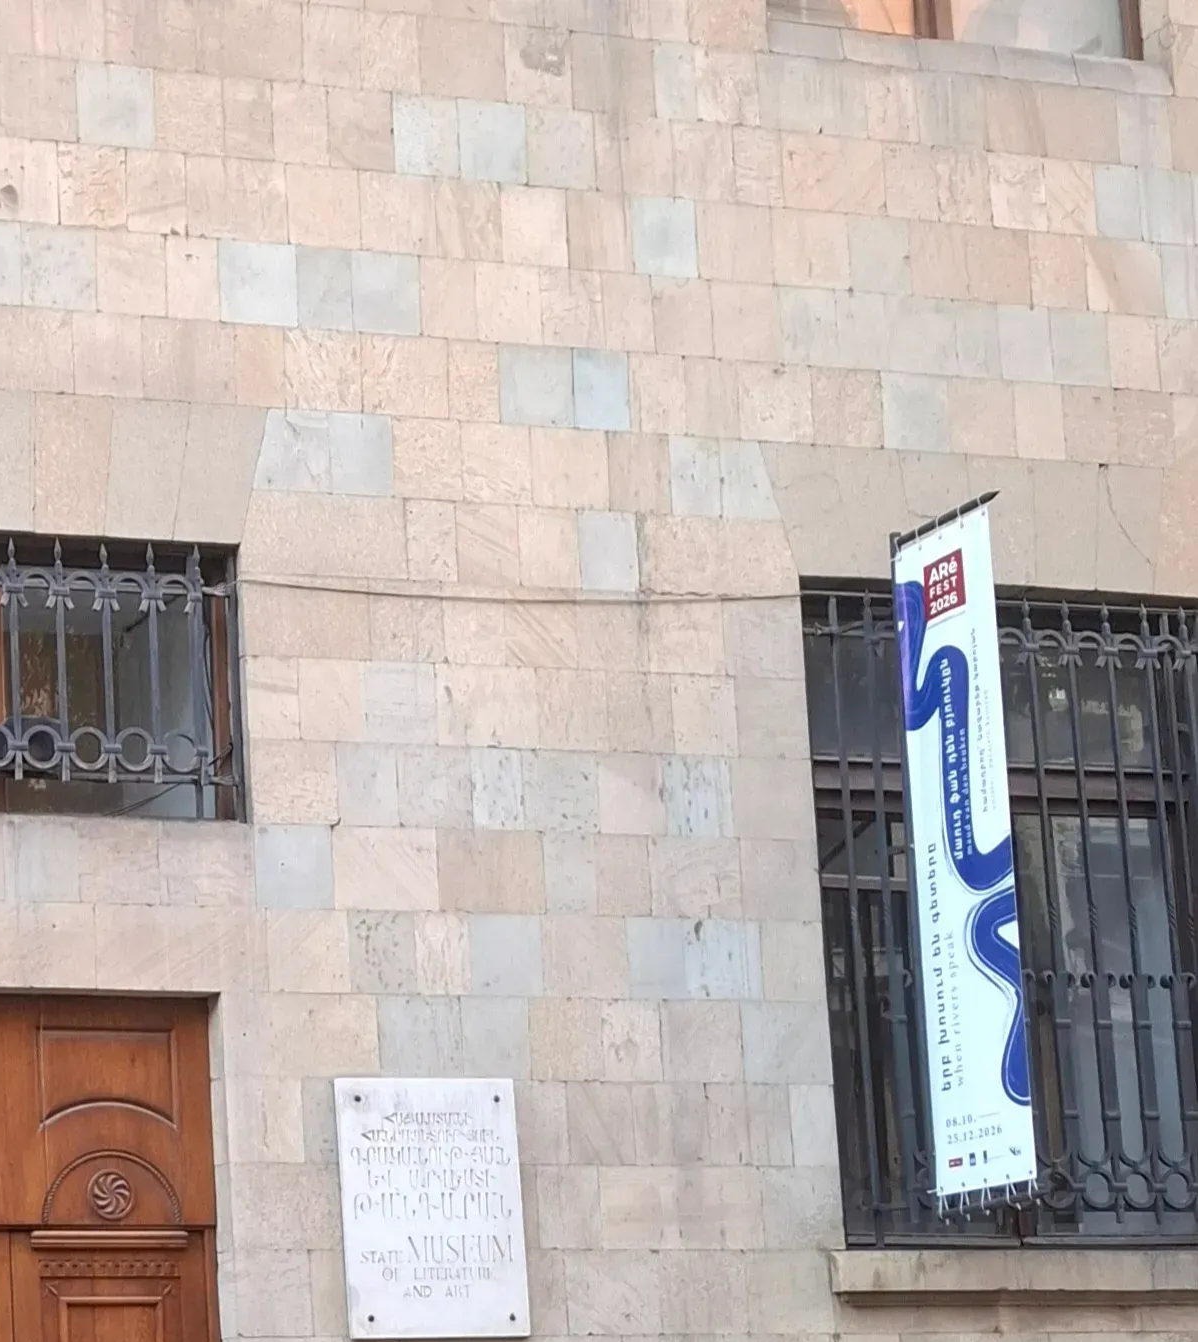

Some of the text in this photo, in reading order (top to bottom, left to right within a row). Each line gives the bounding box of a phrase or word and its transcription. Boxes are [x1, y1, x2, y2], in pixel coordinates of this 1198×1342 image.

[929, 556, 958, 586] ARé
[929, 575, 958, 599] FEST
[929, 591, 958, 615] 2026
[958, 728, 968, 771] beuken
[961, 774, 969, 795] den
[963, 824, 973, 855] maud
[928, 843, 953, 1091] երբ խոսում են գետերը
[944, 931, 963, 1086] when rivers speak
[407, 1235, 513, 1264] MUSEUM
[403, 1284, 432, 1298] AND
